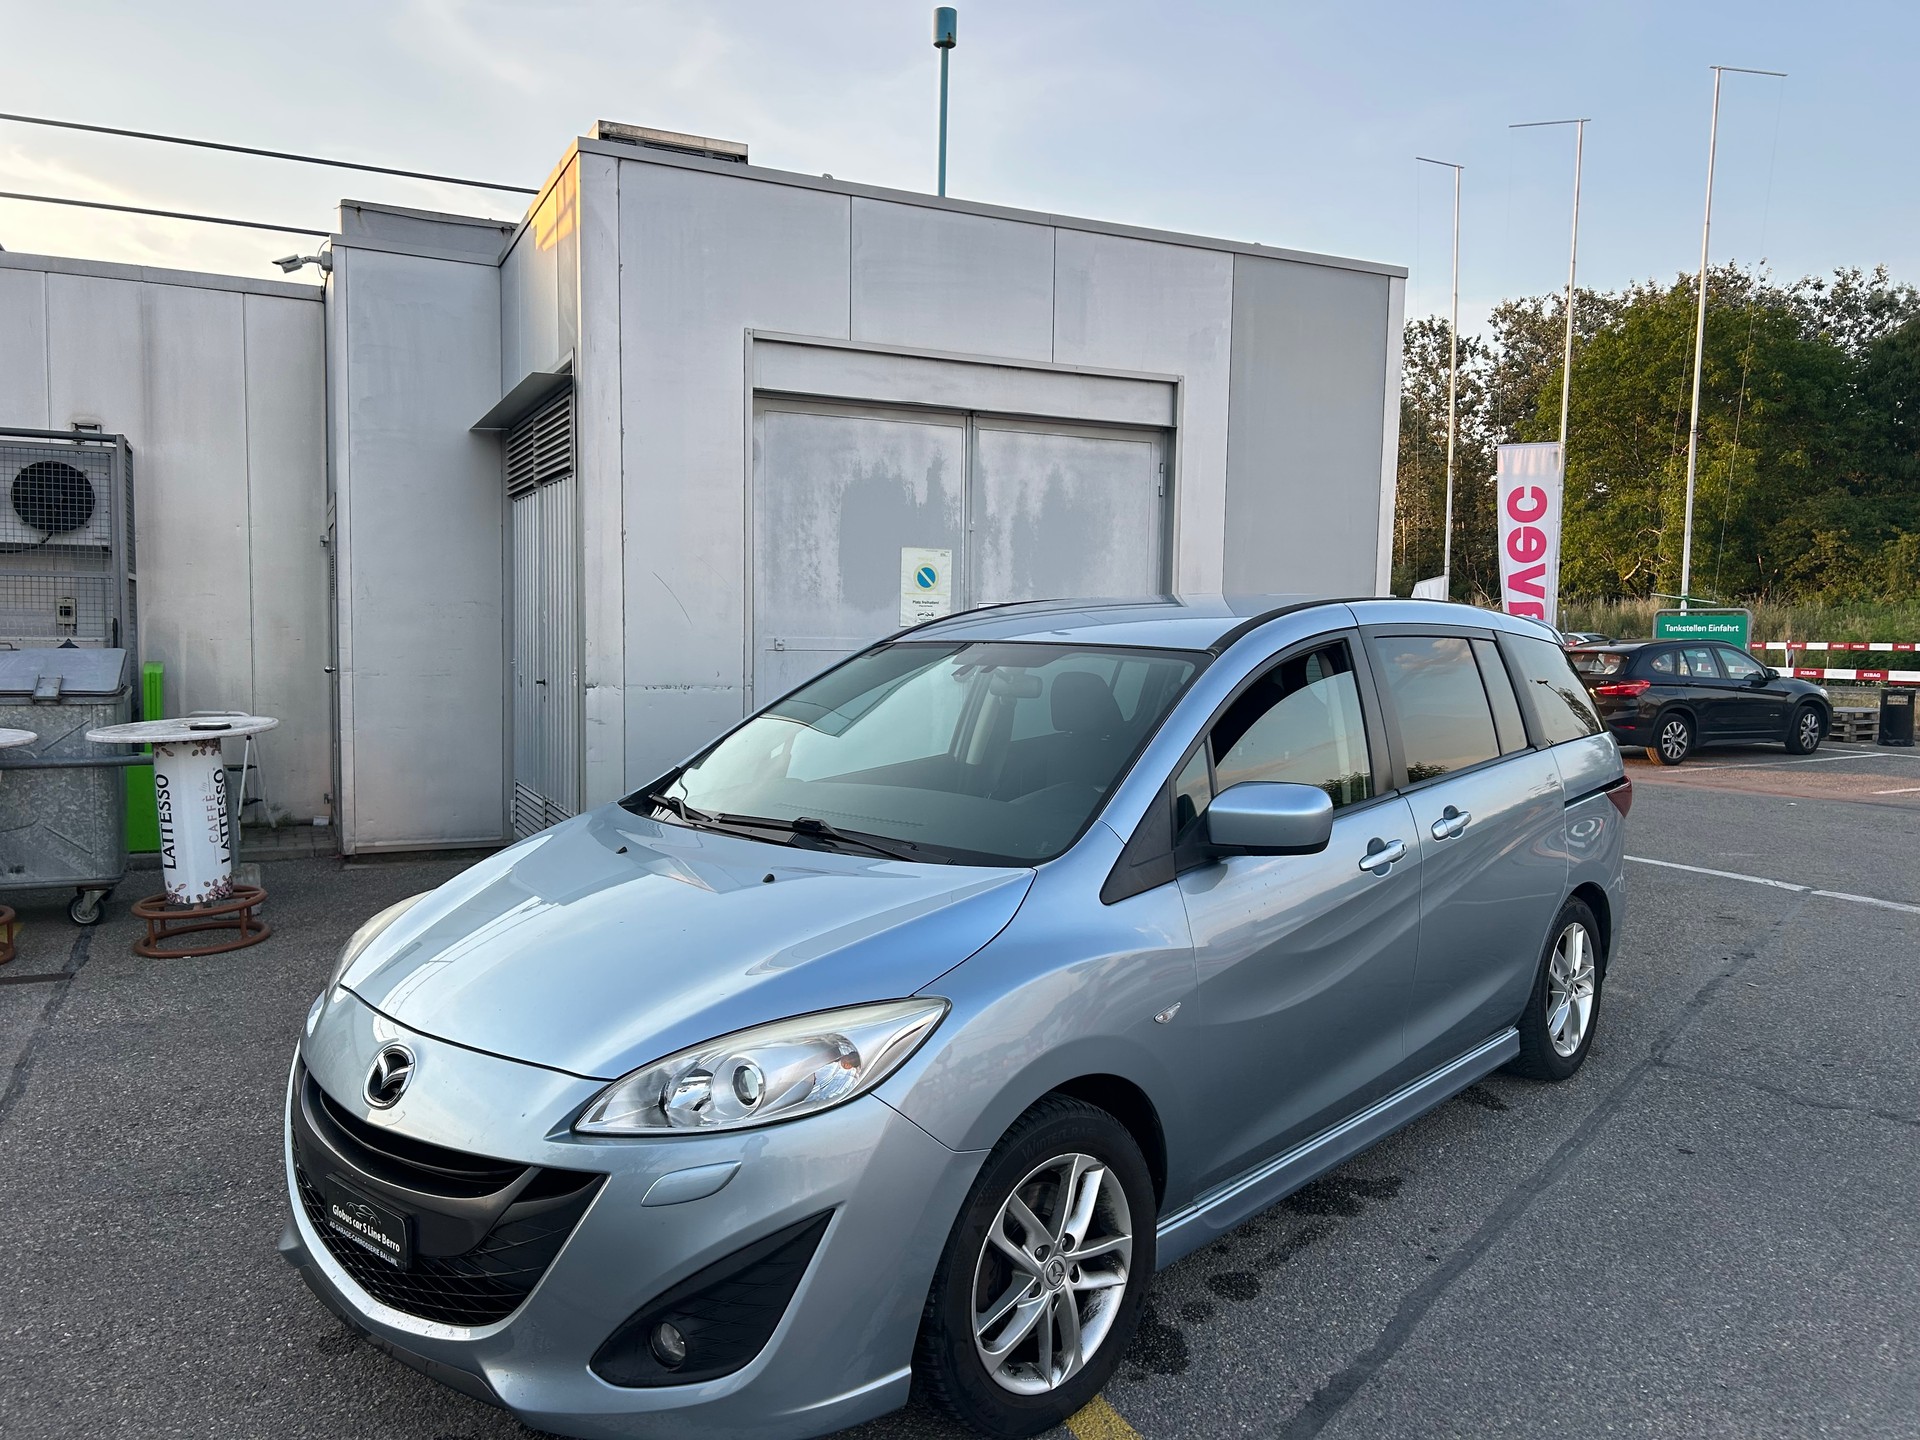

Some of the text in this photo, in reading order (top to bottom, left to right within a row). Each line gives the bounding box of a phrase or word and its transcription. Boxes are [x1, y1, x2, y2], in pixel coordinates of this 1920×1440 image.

[1665, 624, 1739, 632] Tankstellen Einfahrt
[155, 774, 177, 870] LATTESSO
[203, 794, 219, 843] CAFFÈ
[332, 1204, 400, 1252] Globus car S Line Berro
